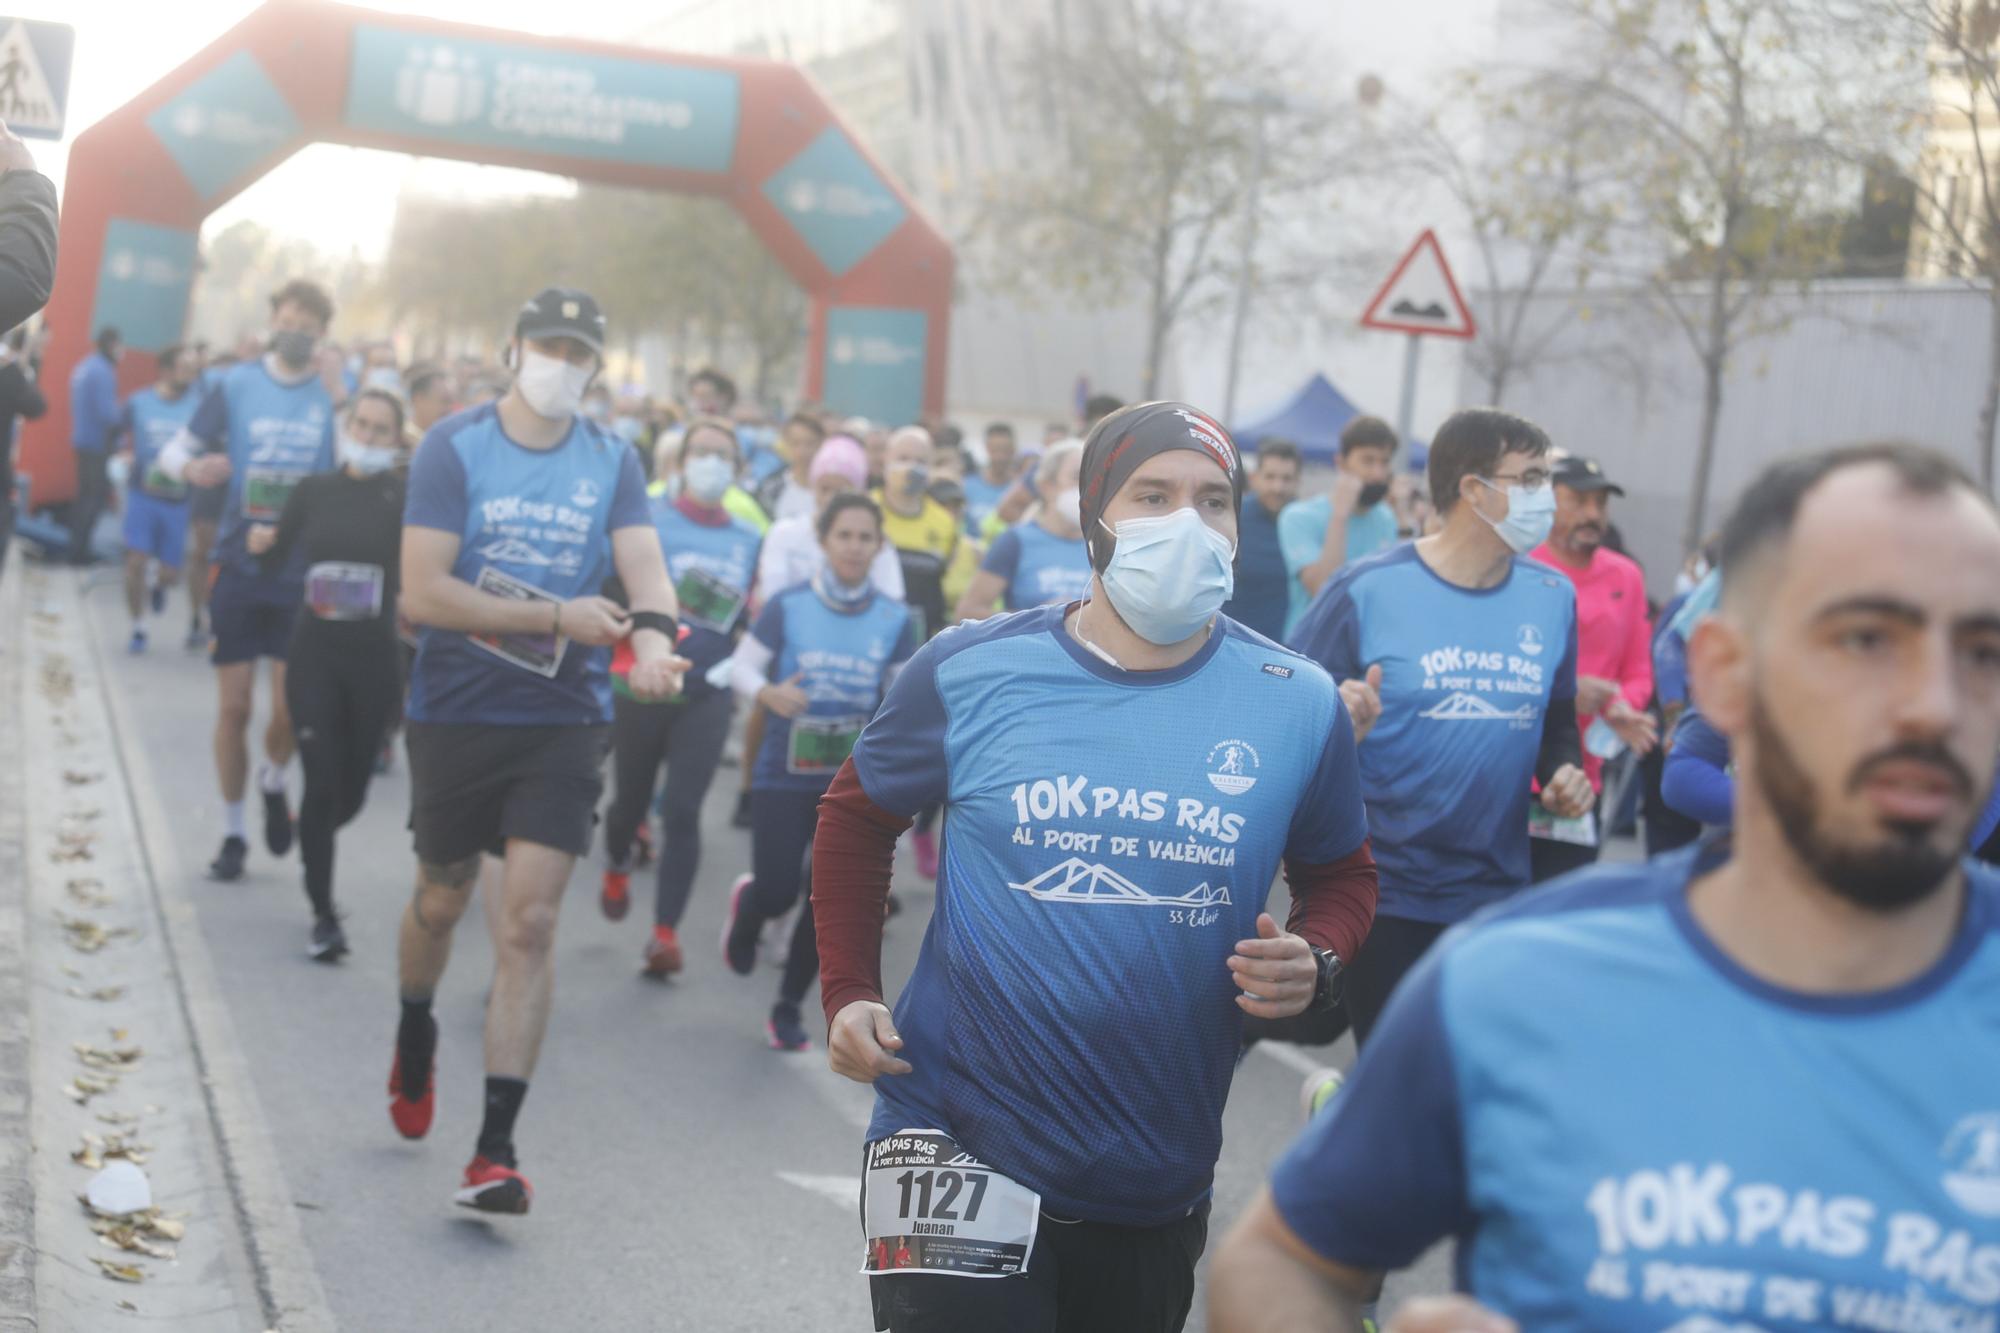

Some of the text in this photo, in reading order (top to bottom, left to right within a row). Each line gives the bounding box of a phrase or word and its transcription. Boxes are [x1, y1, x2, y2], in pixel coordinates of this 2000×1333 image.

[1420, 646, 1542, 682] 10K PAS RAS
[1011, 775, 1245, 844] 10K PAS RAS
[1012, 827, 1235, 867] AL PORT DE VALÈNCIA
[1169, 910, 1183, 923] 33
[875, 1137, 938, 1158] 10K PAS RAS
[895, 1156, 903, 1164] DE
[905, 1153, 935, 1165] VALÈNCIA
[897, 1170, 989, 1221] 1127
[1586, 1162, 1733, 1253] 10K
[1732, 1183, 1877, 1256] PAS
[912, 1221, 954, 1235] Juanan
